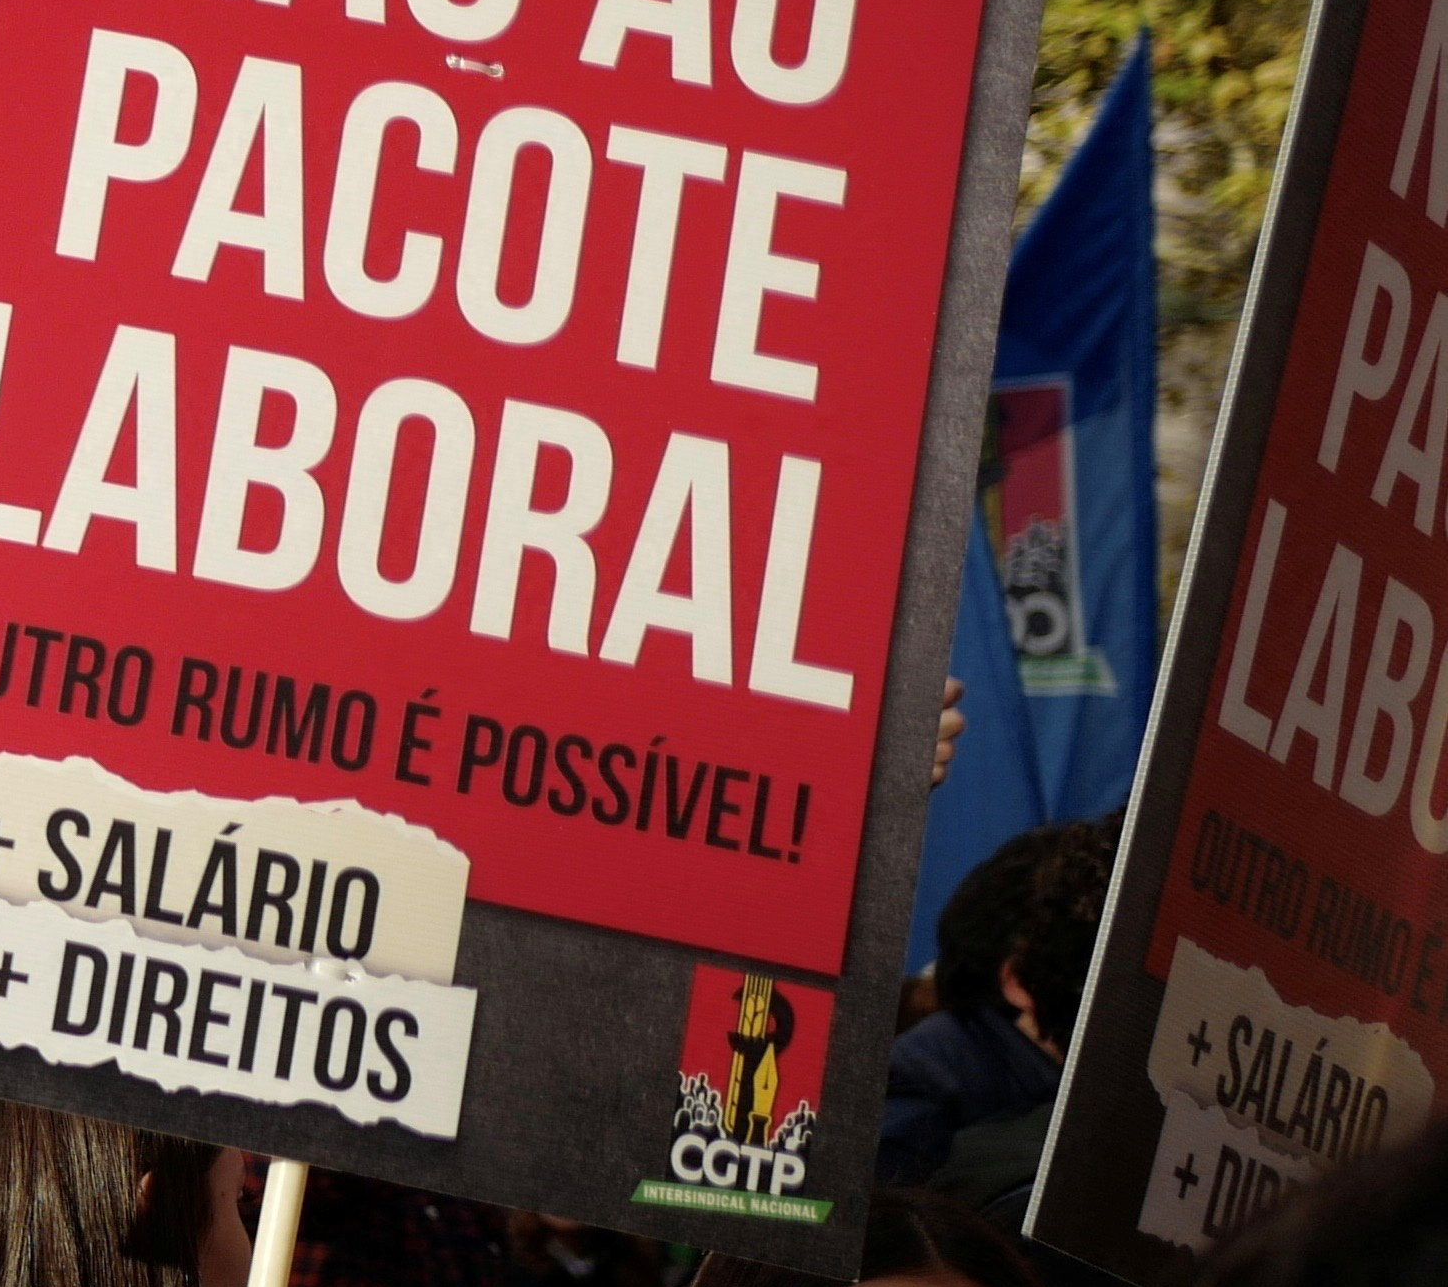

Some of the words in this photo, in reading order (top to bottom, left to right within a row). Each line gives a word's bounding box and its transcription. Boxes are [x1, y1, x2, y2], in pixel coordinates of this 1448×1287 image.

[55, 25, 848, 403] PACOTE
[169, 651, 377, 775] RUMO
[394, 688, 443, 788] É
[457, 716, 812, 866] POSSÍVEL!
[1219, 499, 1448, 855] LABO
[37, 805, 381, 961] SALÁRIO
[1190, 810, 1309, 941] OUTRO
[1308, 874, 1412, 997] RUMO
[51, 939, 420, 1104] DIREITOS
[1217, 1014, 1389, 1165] SALÁRIO
[643, 1185, 746, 1211] INTERSINDICAL
[750, 1197, 819, 1219] NACIONAL
[670, 1133, 806, 1196] CGTP
